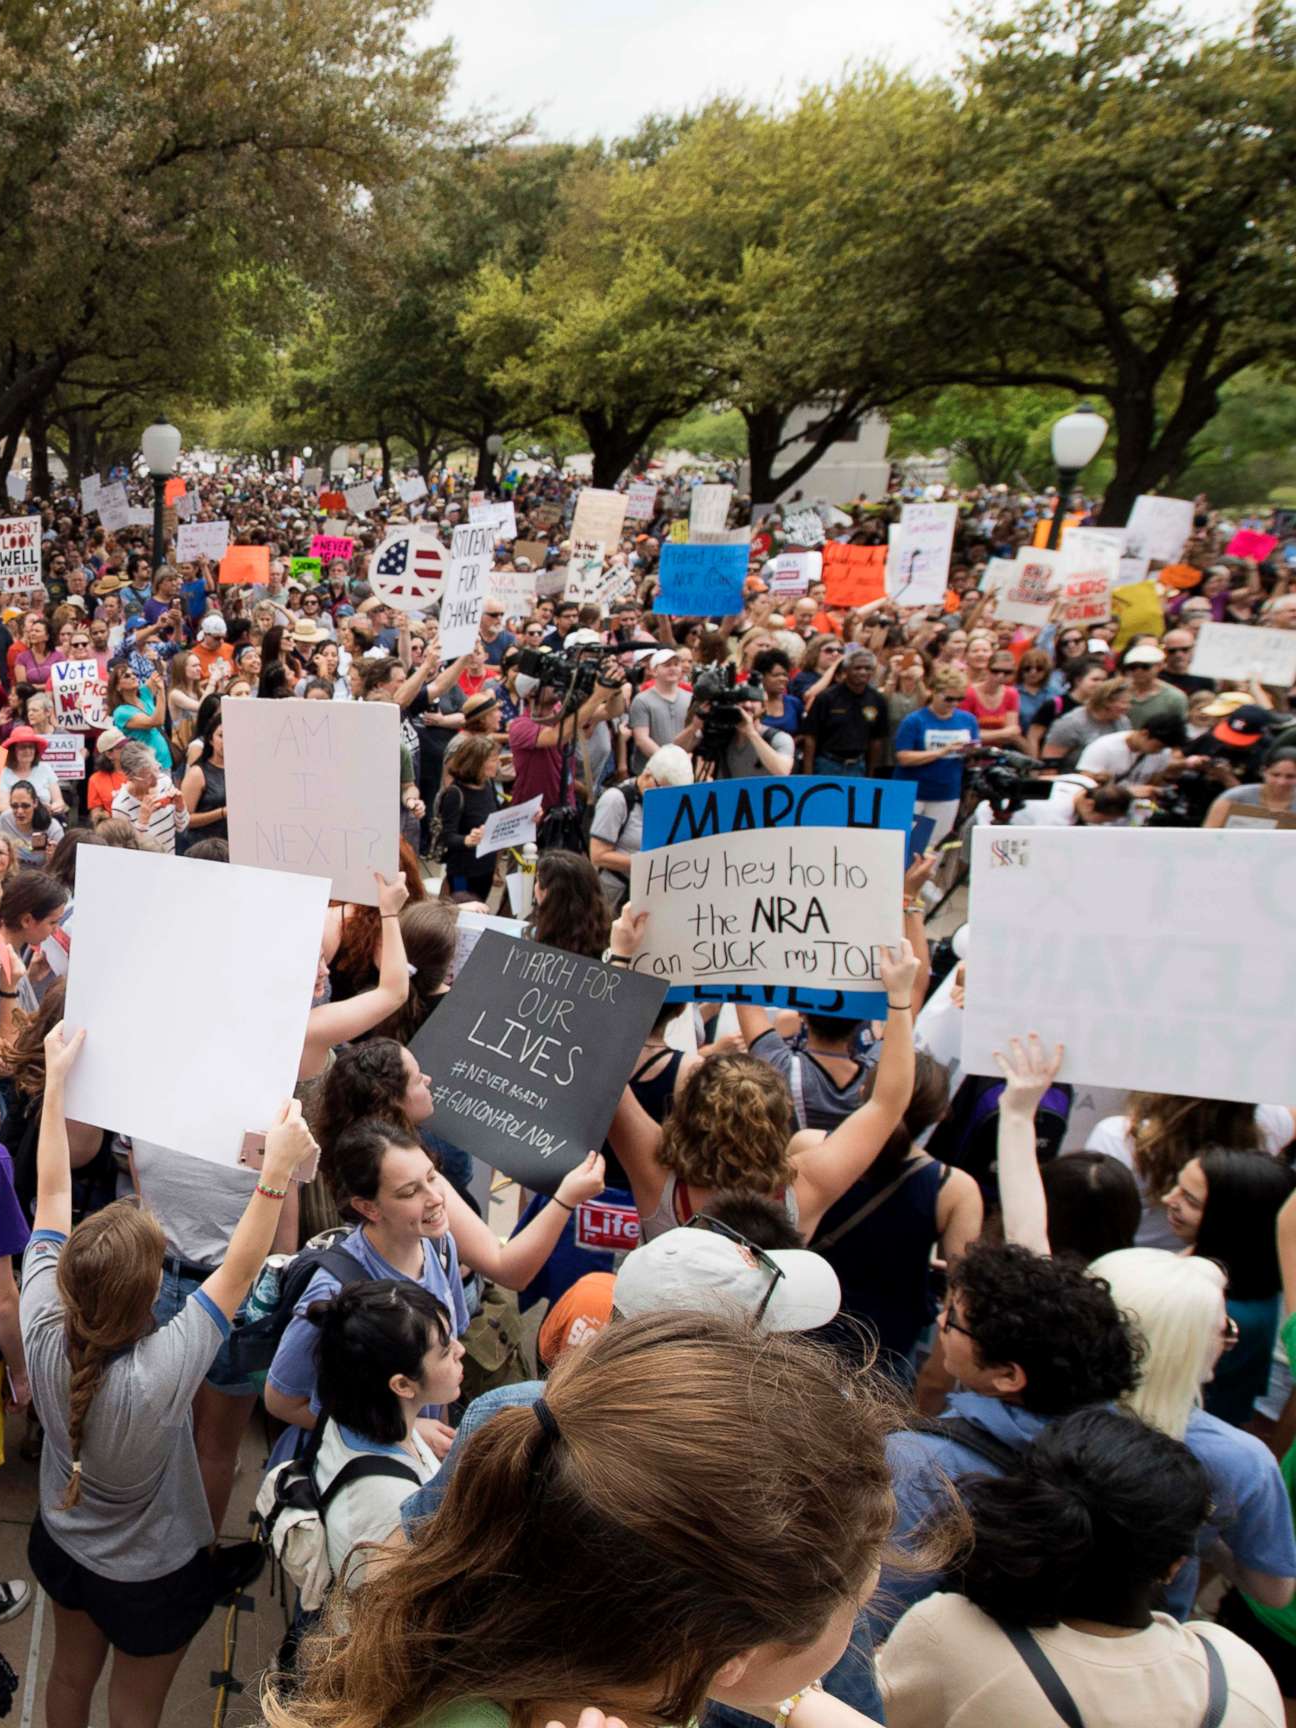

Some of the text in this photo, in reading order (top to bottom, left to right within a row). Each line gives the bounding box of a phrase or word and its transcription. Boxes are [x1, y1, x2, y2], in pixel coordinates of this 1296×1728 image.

[0, 549, 39, 567] WELL
[2, 534, 34, 550] LOOK
[456, 563, 481, 594] FOR
[46, 740, 75, 749] EXAS
[272, 714, 333, 760] AM
[288, 770, 321, 811] I
[255, 821, 382, 872] NEXT?
[646, 855, 710, 897] Hey
[723, 849, 776, 887] hey
[688, 895, 831, 937] the NRA
[502, 944, 622, 1005] MARCH FOR
[690, 939, 767, 973] SUCK
[785, 948, 818, 974] my
[517, 987, 576, 1033] OUR
[467, 1010, 583, 1087] LIVES
